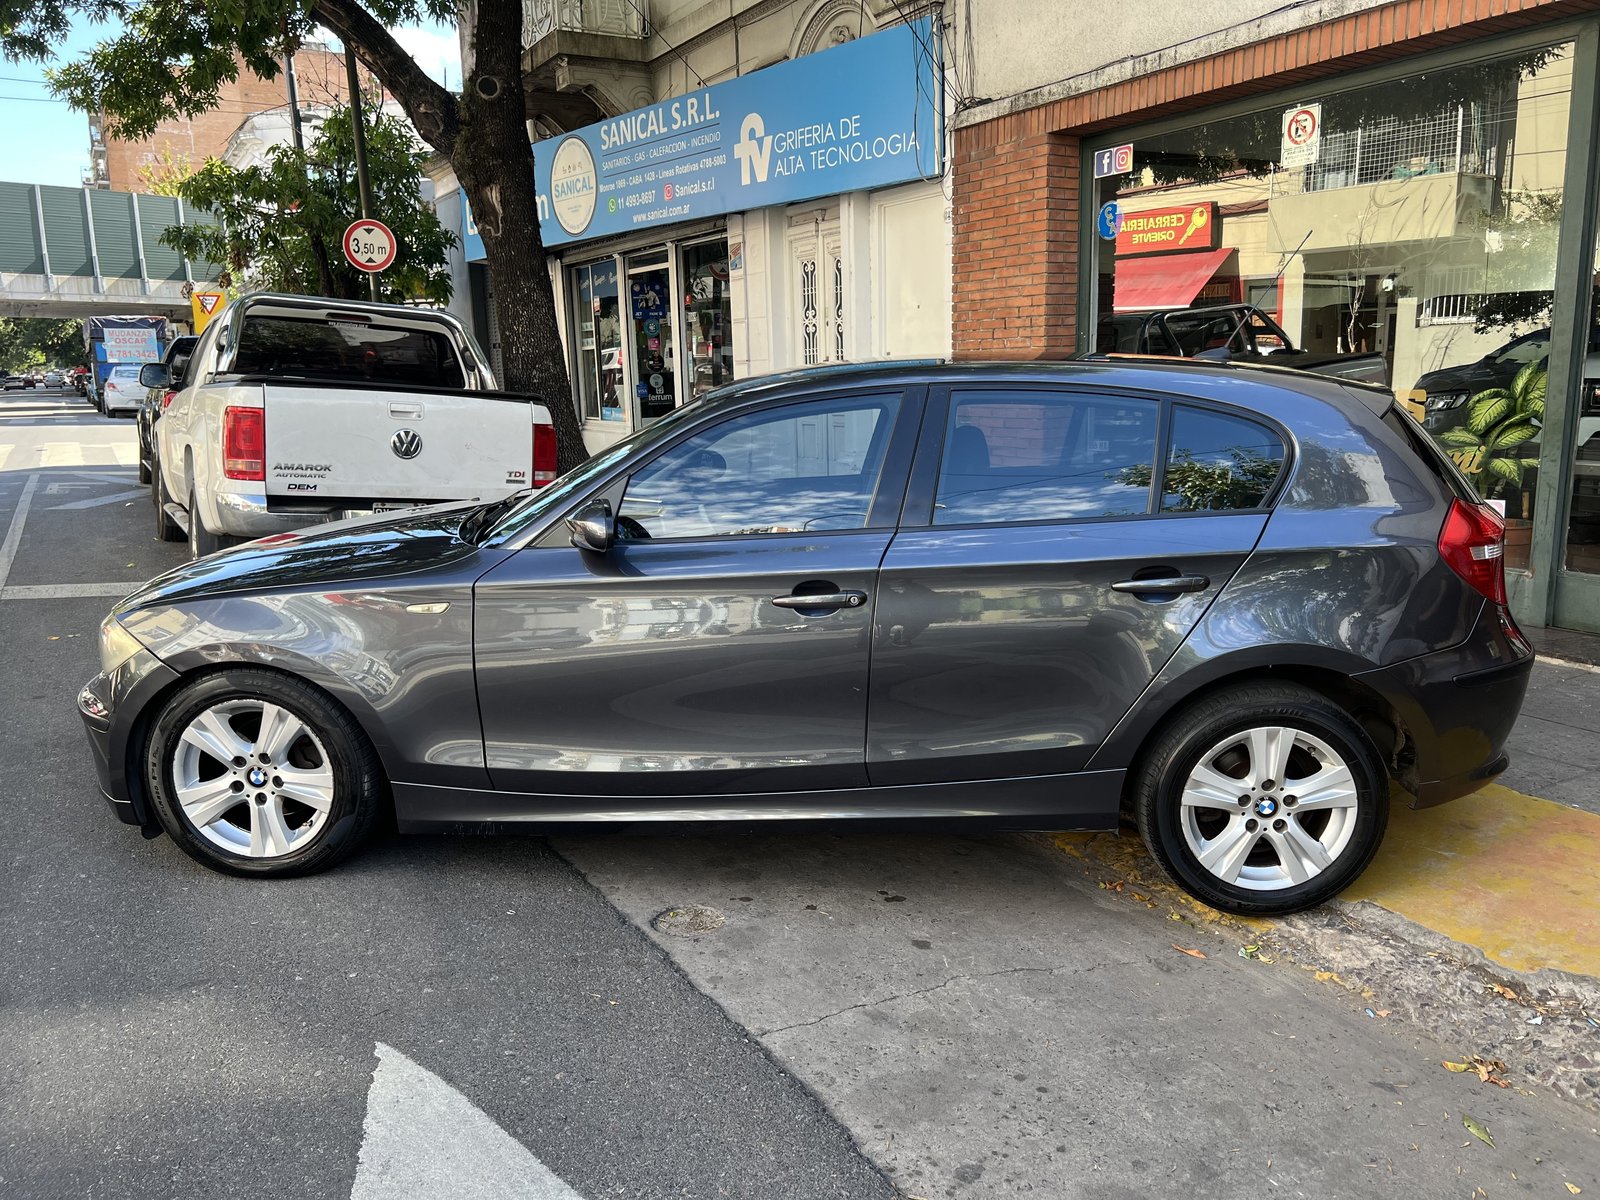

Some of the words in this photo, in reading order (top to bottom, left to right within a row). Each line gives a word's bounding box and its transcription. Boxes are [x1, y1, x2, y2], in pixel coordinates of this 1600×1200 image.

[600, 108, 668, 150] SANICAL
[671, 93, 720, 130] S.R.L.
[774, 121, 835, 154] GRIFERIA
[840, 115, 861, 140] DE
[602, 155, 631, 171] SANITARIOS
[634, 151, 646, 161] GAS
[649, 141, 687, 159] CALEFACCION
[691, 131, 721, 147] INCENDIO
[774, 155, 805, 178] ALTA
[810, 131, 921, 170] TECNOLOGIA
[629, 174, 643, 186] CABA
[675, 162, 699, 175] Rotativas
[554, 176, 593, 199] SANICAL
[618, 196, 625, 209] 11
[632, 204, 690, 224] www.sanical.com.ar
[352, 237, 375, 256] 3,50
[377, 246, 387, 255] m
[107, 330, 152, 338] MUDANZAS
[648, 393, 673, 401] ferrum
[273, 463, 332, 472] AMAROK
